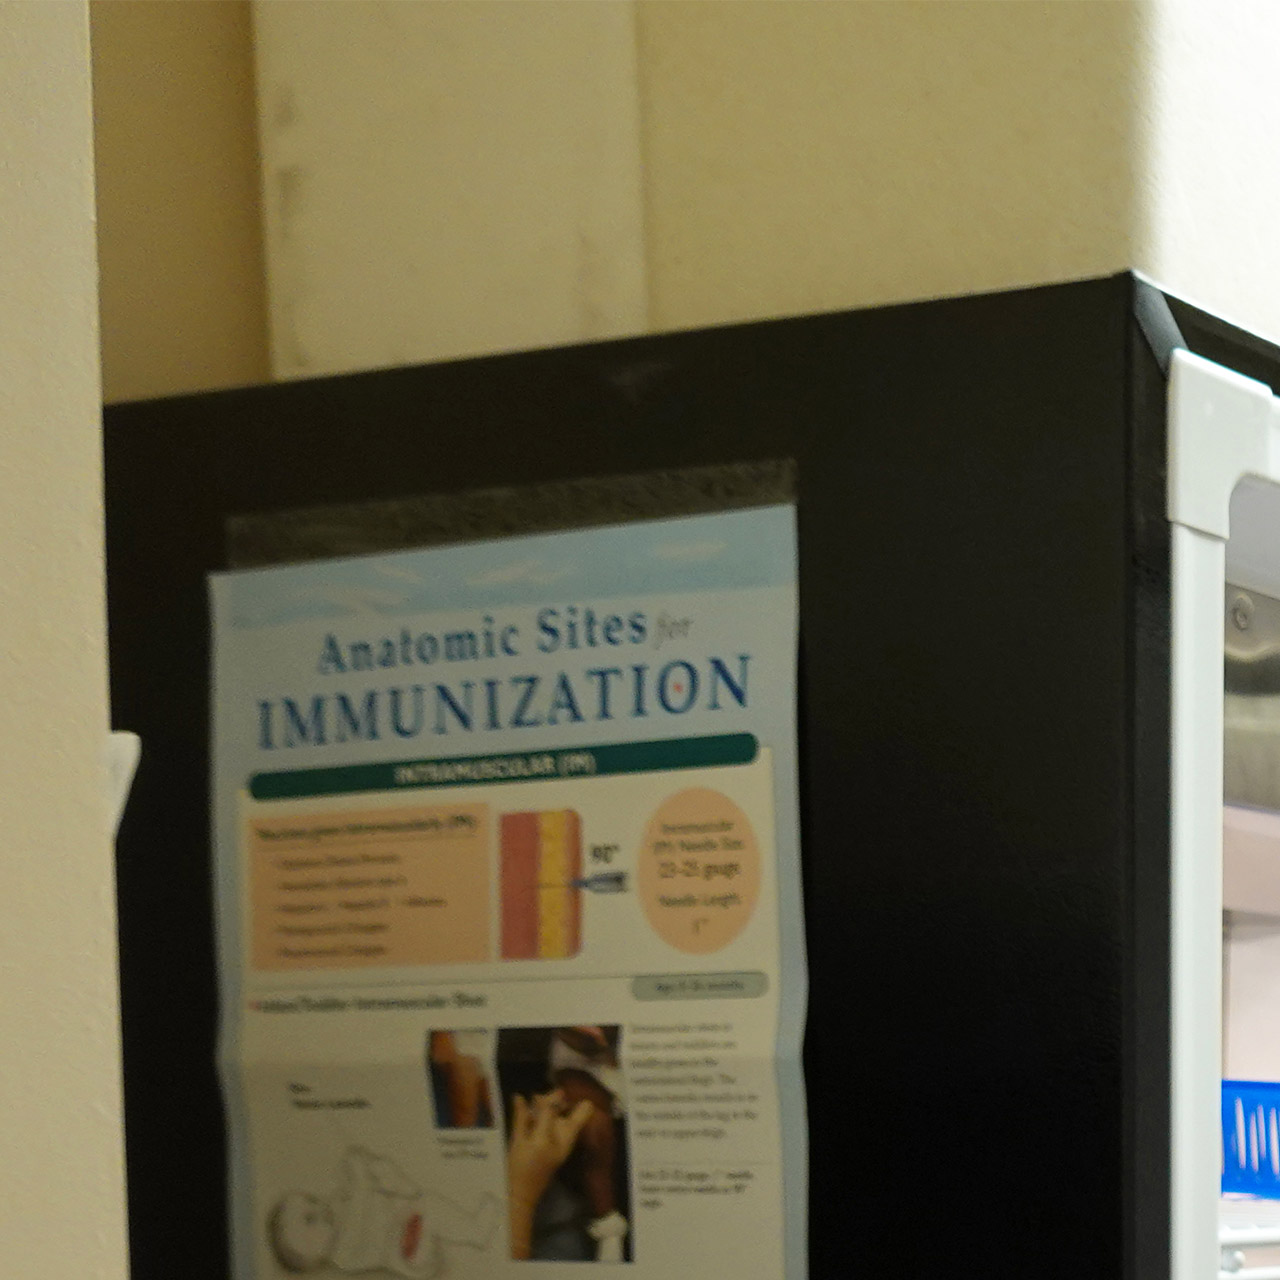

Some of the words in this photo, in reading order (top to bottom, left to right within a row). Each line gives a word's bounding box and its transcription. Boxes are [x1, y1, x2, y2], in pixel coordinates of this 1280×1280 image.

[317, 614, 521, 675] Anatomic
[536, 606, 648, 652] Sites
[653, 611, 695, 649] for
[258, 653, 752, 751] IMMUNIZATION
